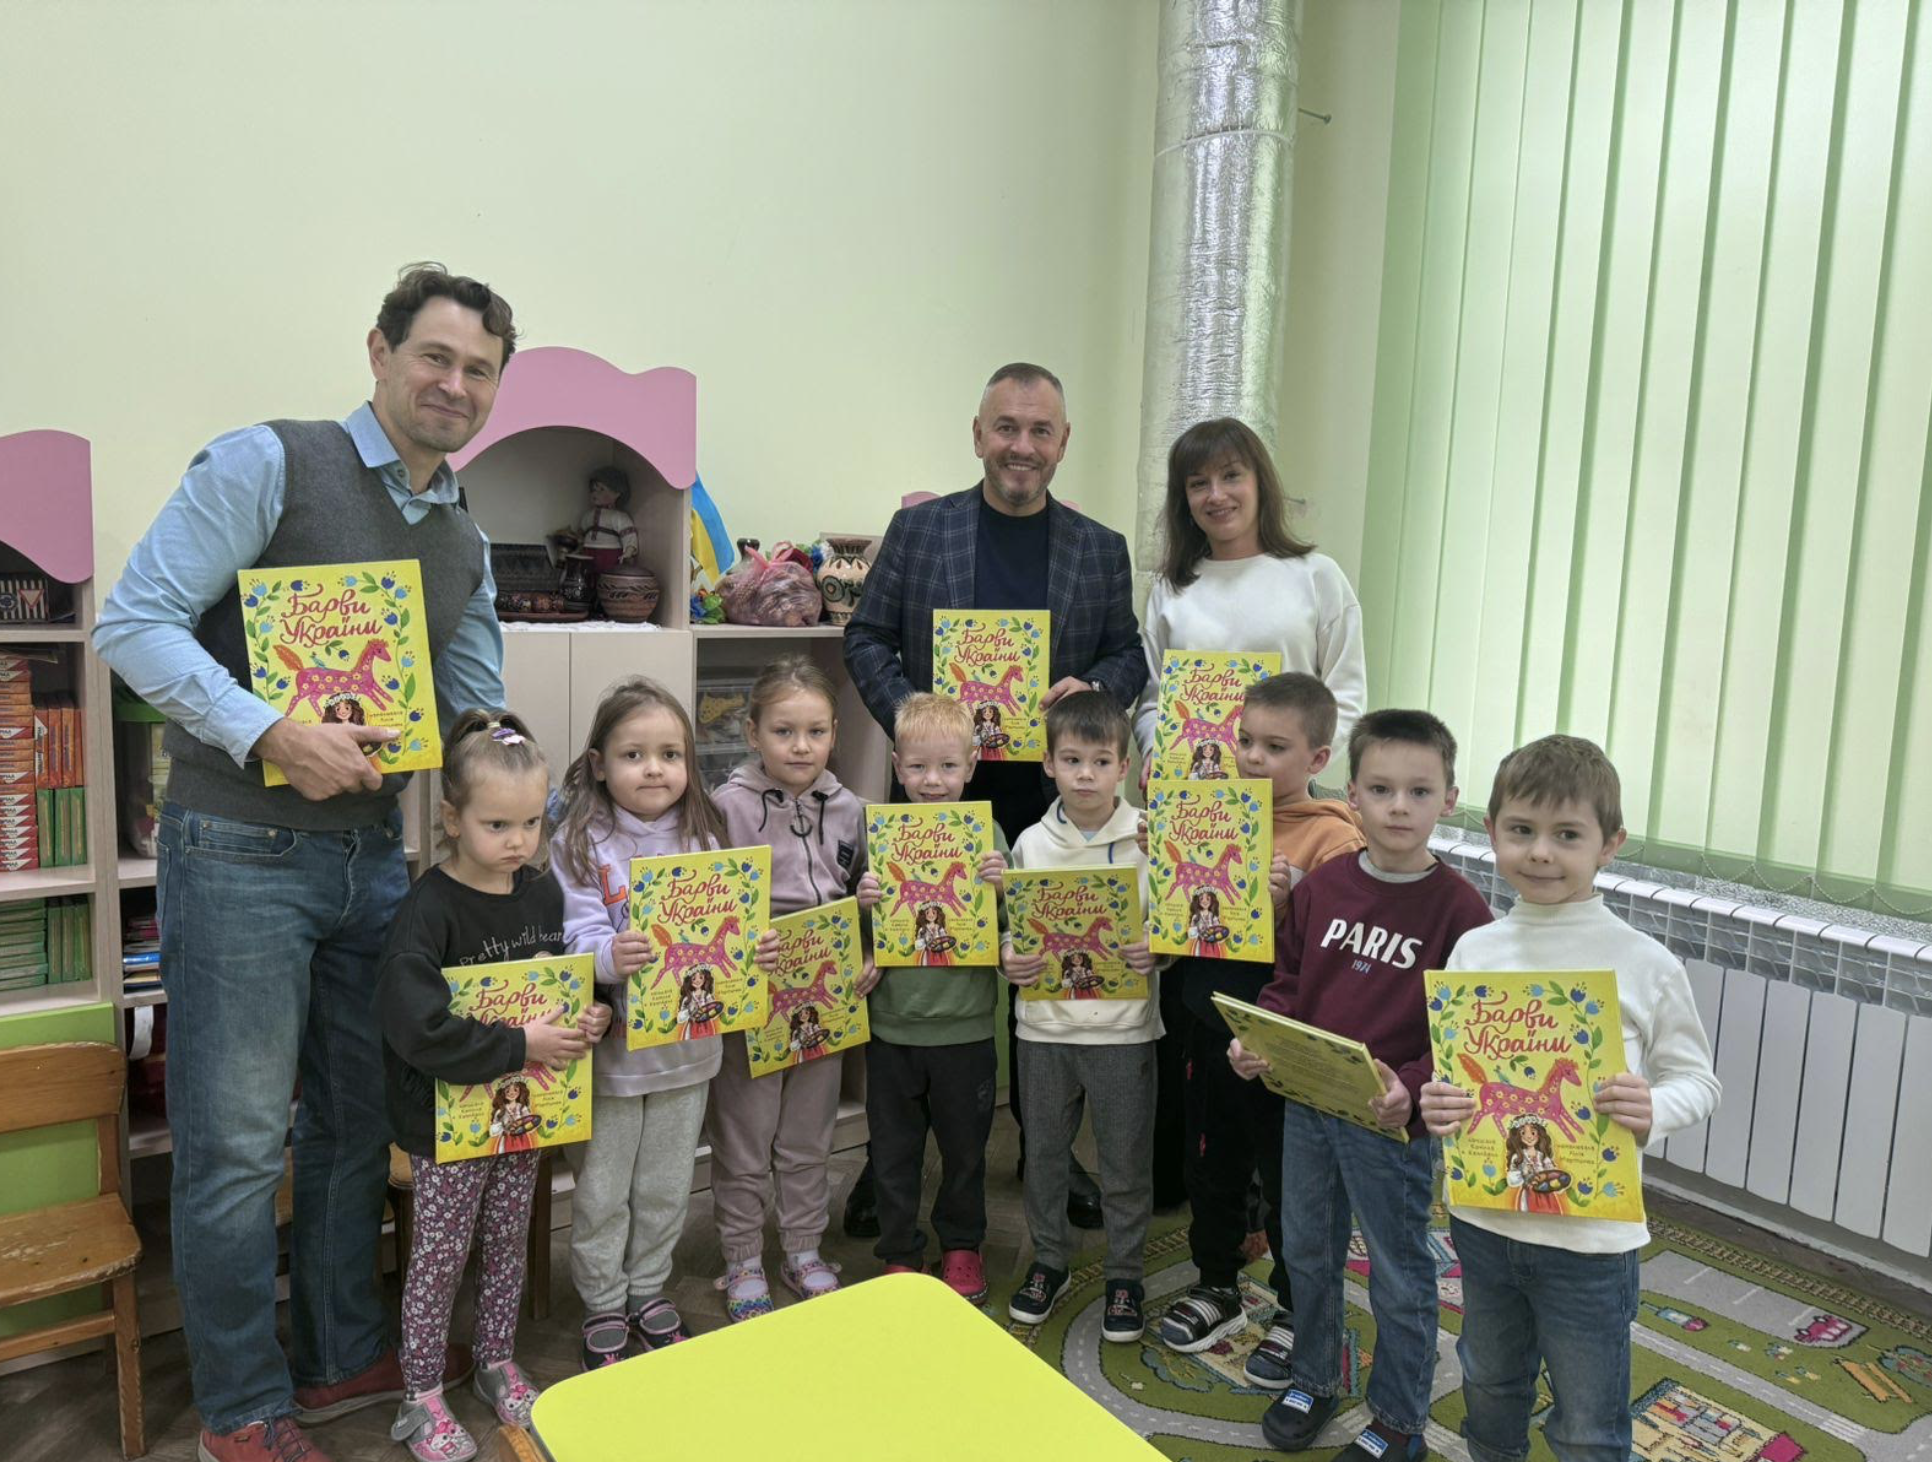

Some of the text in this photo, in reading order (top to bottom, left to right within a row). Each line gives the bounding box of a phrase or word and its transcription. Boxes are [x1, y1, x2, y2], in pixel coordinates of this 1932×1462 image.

[281, 583, 371, 622] Барви
[280, 617, 383, 648] України
[957, 622, 1014, 650] Барви
[954, 645, 1020, 667] України
[1184, 663, 1242, 689] Барви
[1180, 684, 1245, 705] України
[1171, 795, 1231, 826] Барви
[893, 817, 955, 847] Барви
[1169, 821, 1238, 846] України
[891, 842, 963, 866] України
[661, 869, 731, 904] Барви
[1032, 881, 1098, 906] Барви
[657, 898, 737, 926] України
[1031, 901, 1107, 921] України
[511, 925, 537, 949] wild
[1320, 918, 1423, 969] PARIS
[469, 979, 547, 1015] Барви
[1464, 990, 1559, 1034] Барви
[1463, 1025, 1572, 1060] України
